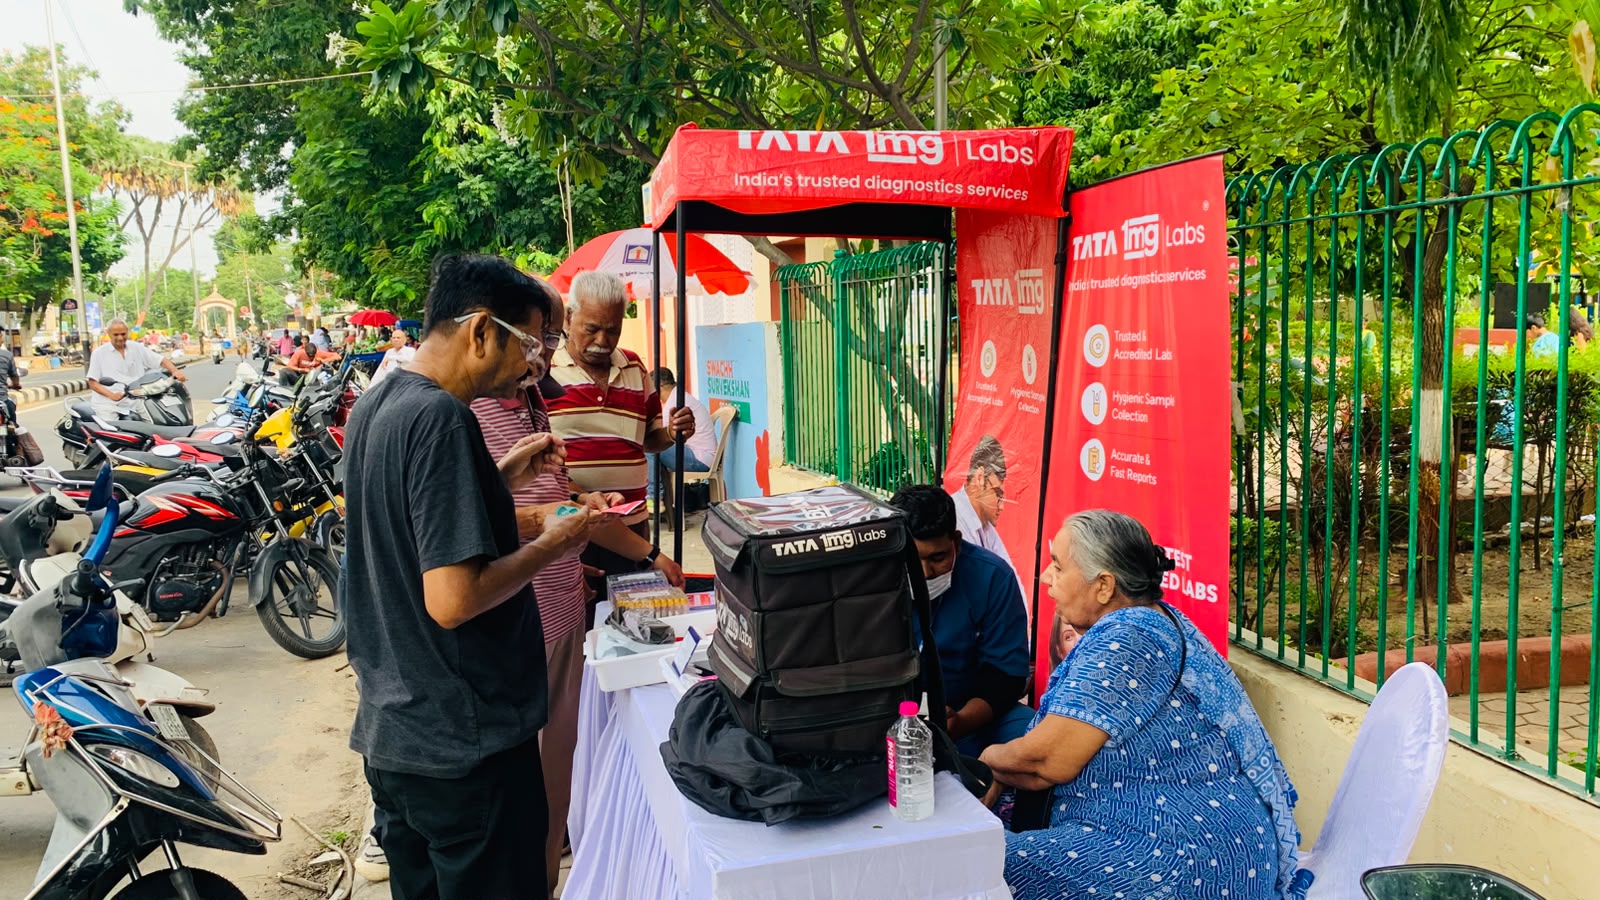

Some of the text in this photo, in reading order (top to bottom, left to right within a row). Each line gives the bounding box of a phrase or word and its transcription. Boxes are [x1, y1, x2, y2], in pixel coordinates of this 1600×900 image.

[738, 130, 1034, 166] TATA 1mg Labs
[735, 173, 1029, 201] India's trusted diagnostics services
[1073, 214, 1205, 260] TATA 1mg Labs
[972, 269, 1044, 315] TATA 1mg
[1090, 275, 1119, 289] trusted
[1114, 330, 1141, 342] Trusted
[1112, 390, 1144, 405] Hygienic
[1111, 449, 1151, 465] Accurate &
[1110, 466, 1157, 485] Fast Reports
[772, 530, 886, 556] TATA 1mg Labs
[1182, 576, 1218, 603] LABS
